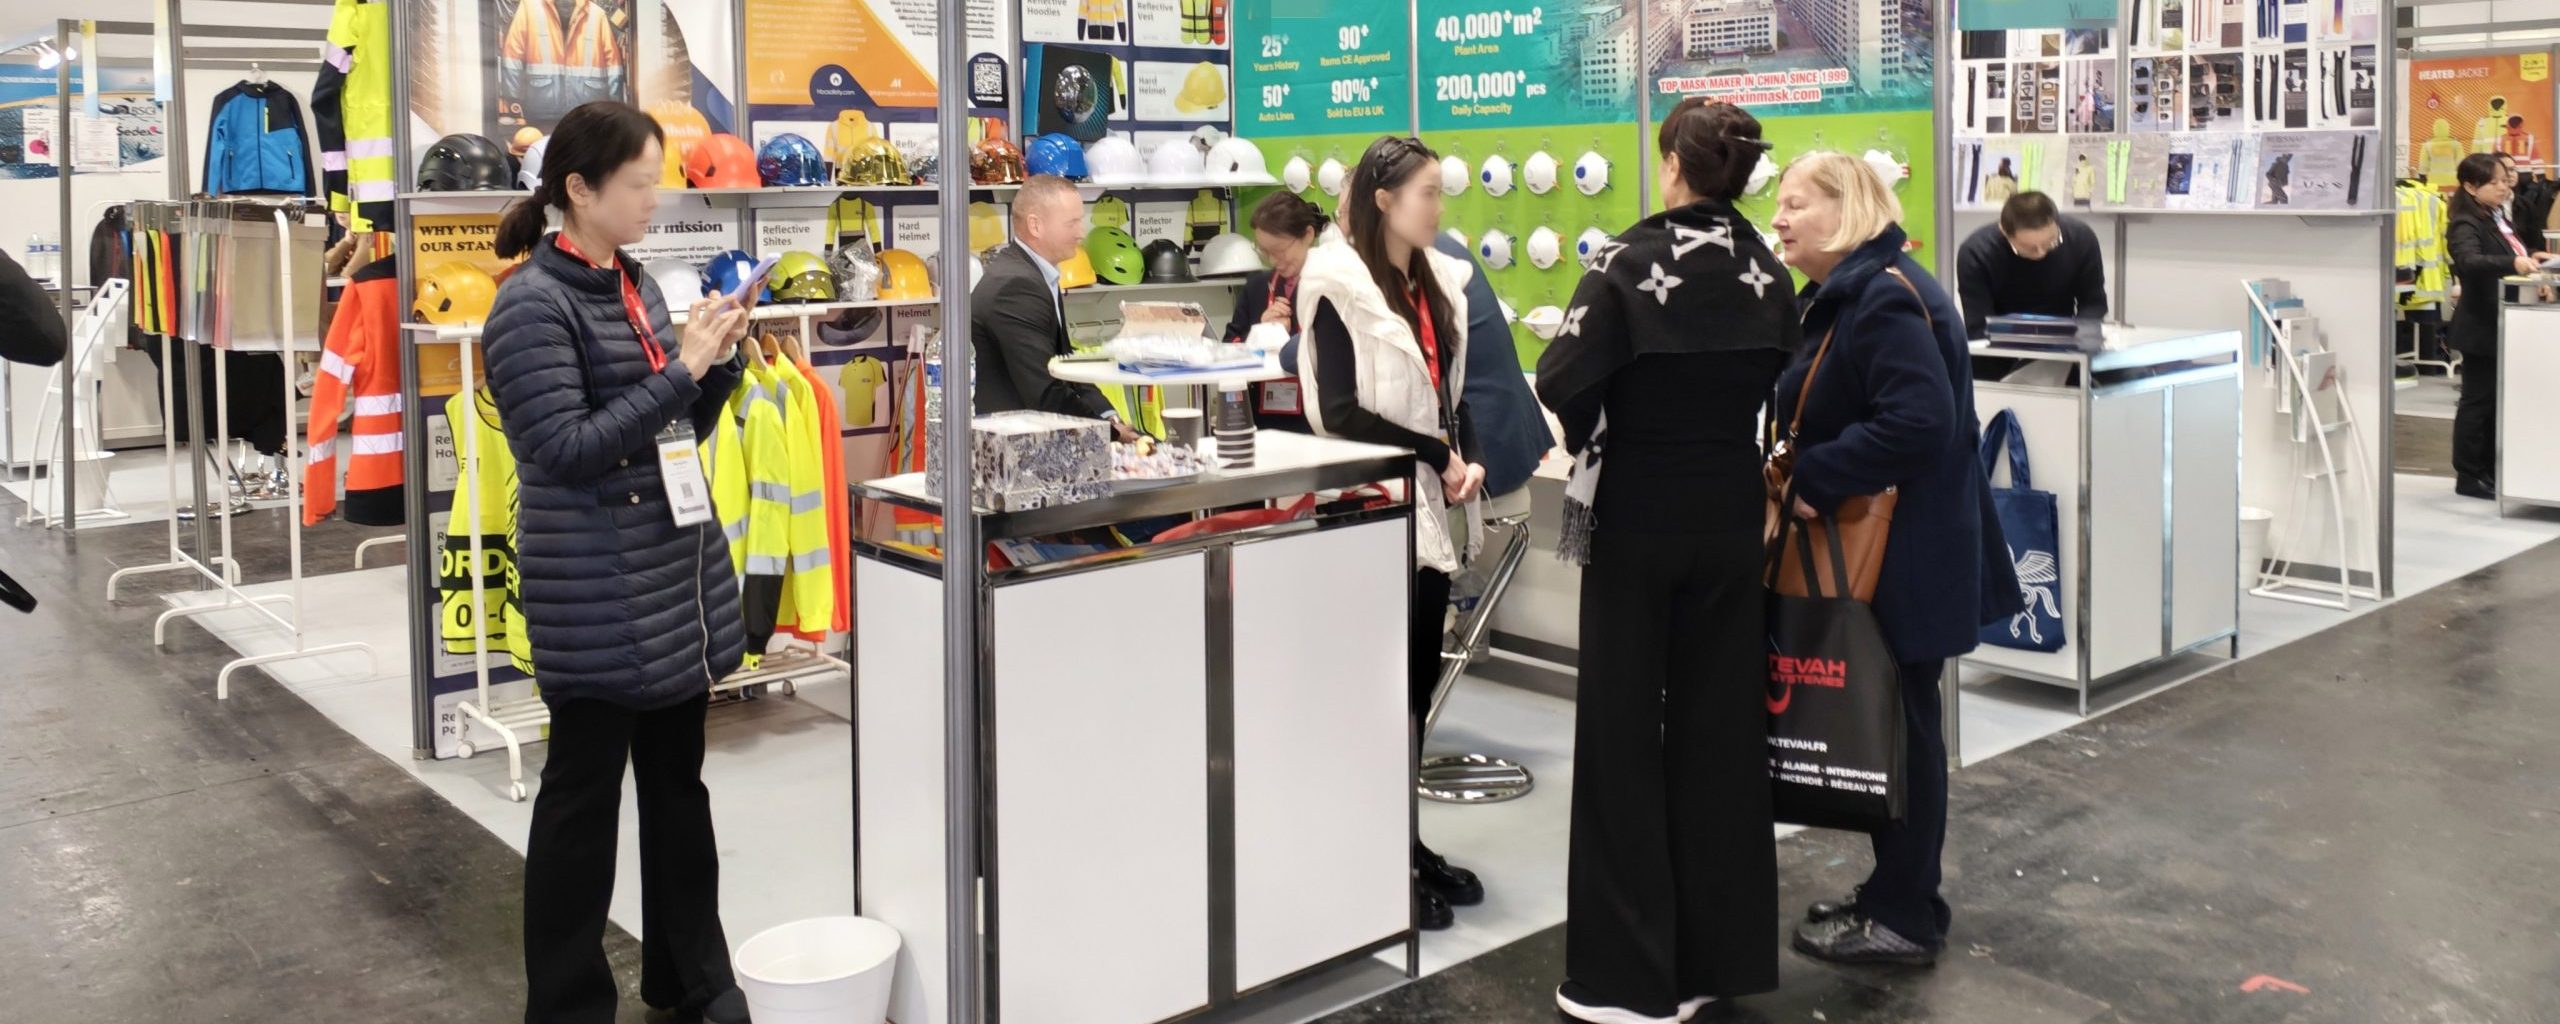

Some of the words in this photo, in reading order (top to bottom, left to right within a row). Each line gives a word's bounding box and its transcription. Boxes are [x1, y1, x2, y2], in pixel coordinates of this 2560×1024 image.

[1027, 7, 1061, 17] Hoodies
[1137, 3, 1173, 11] Reflective
[1137, 13, 1153, 21] Vest
[1454, 45, 1477, 56] Plant
[1477, 44, 1499, 54] Area
[1353, 51, 1391, 65] Approved
[1253, 62, 1274, 71] Years
[1274, 61, 1300, 71] History
[2418, 69, 2455, 80] HEATED
[2455, 67, 2490, 78] JACKET
[1138, 76, 1158, 85] Hard
[1660, 80, 1677, 92] TOP
[1680, 78, 1707, 91] MASK
[1709, 77, 1742, 89] MAKER
[1745, 75, 1754, 86] IN
[1757, 73, 1787, 86] CHINA
[1789, 71, 1818, 84] SINCE
[1821, 70, 1847, 82] 1999
[1138, 87, 1166, 96] Helmet
[1326, 108, 1343, 118] Sold
[1352, 107, 1364, 117] EU
[1371, 106, 1385, 116] UK
[1451, 104, 1472, 116] Daily
[1473, 102, 1512, 115] Capacity
[117, 126, 156, 137] Sedex
[898, 221, 920, 231] Hard
[1139, 217, 1172, 226] Reflector
[419, 225, 456, 236] WHY
[645, 224, 660, 234] ur
[664, 220, 723, 234] mission
[762, 225, 810, 235] Reflective
[898, 231, 931, 241] Helmet
[420, 242, 452, 253] OUR
[456, 241, 497, 252] STAN
[762, 237, 792, 247] Shites
[897, 309, 931, 318] Helmet
[1782, 760, 1820, 773] ALARME
[1826, 766, 1888, 783] INTERPHONIE
[1780, 772, 1823, 786] INCENDIE
[1830, 779, 1868, 793] RÉSEAU
